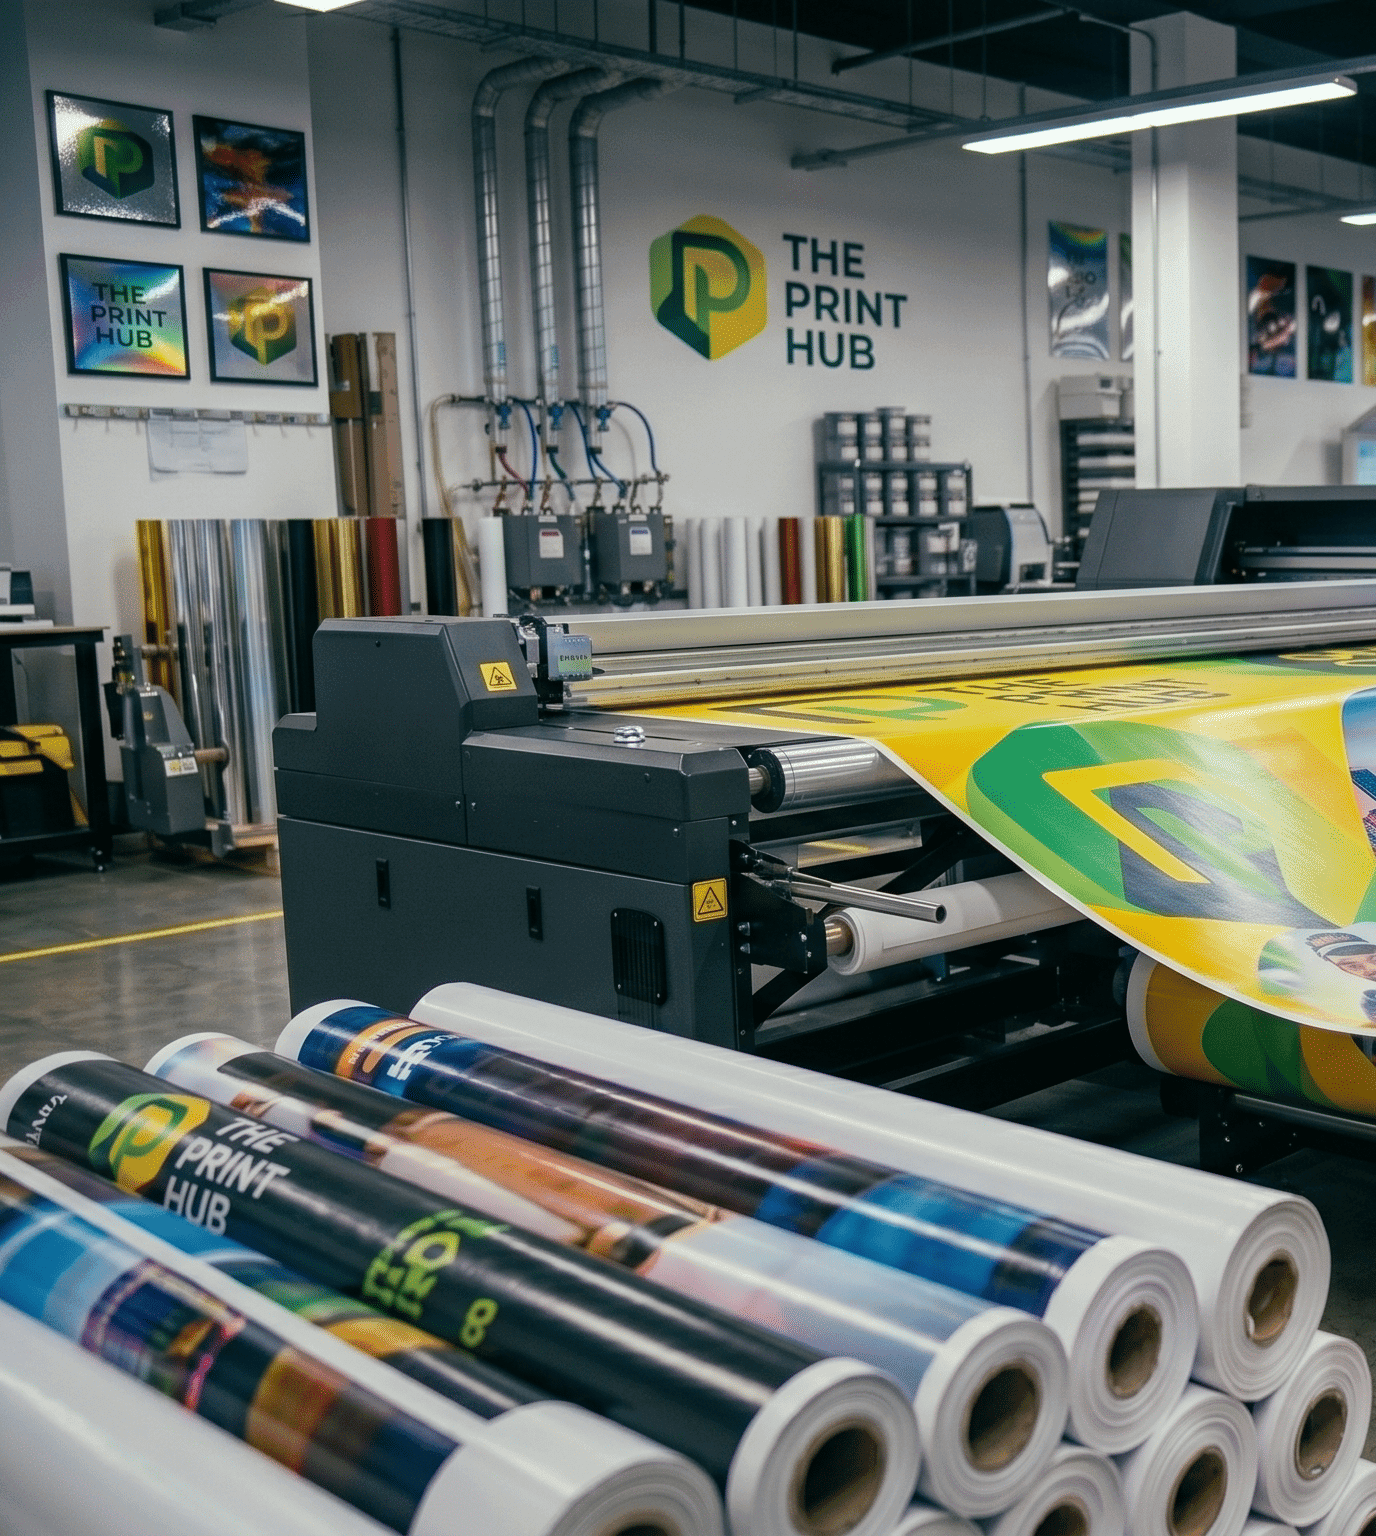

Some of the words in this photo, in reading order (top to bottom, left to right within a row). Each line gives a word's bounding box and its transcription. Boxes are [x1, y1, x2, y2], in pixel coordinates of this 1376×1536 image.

[782, 232, 866, 280] THE
[91, 282, 147, 306] THE
[785, 280, 908, 329] PRINT
[91, 305, 167, 328] PRINT
[96, 327, 154, 349] HUB
[786, 327, 876, 371] HUB
[215, 1116, 300, 1155] THE
[174, 1135, 292, 1200] PRINT
[163, 1175, 231, 1237] HUB
